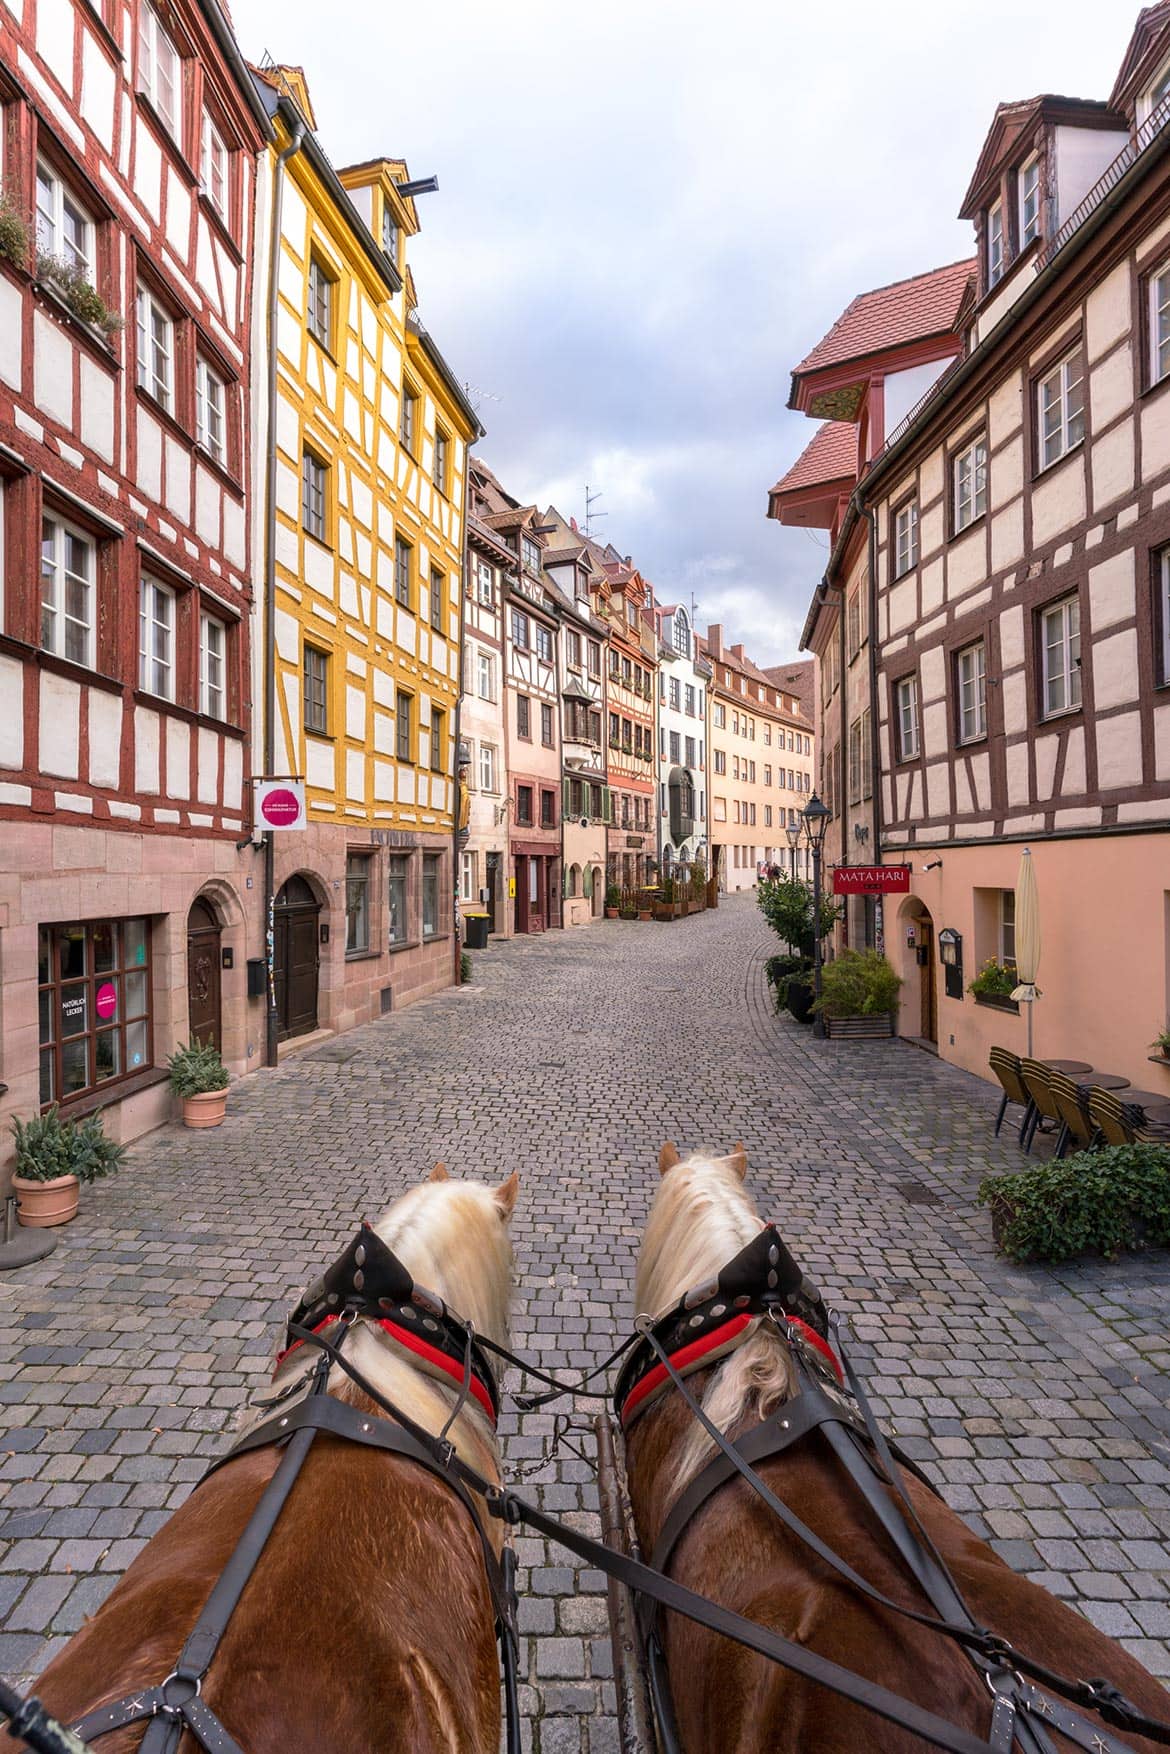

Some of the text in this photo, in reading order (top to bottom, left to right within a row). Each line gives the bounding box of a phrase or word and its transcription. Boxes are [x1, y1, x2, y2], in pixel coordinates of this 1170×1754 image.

[839, 871, 904, 882] MATA HARI
[66, 1006, 83, 1017] LECKER
